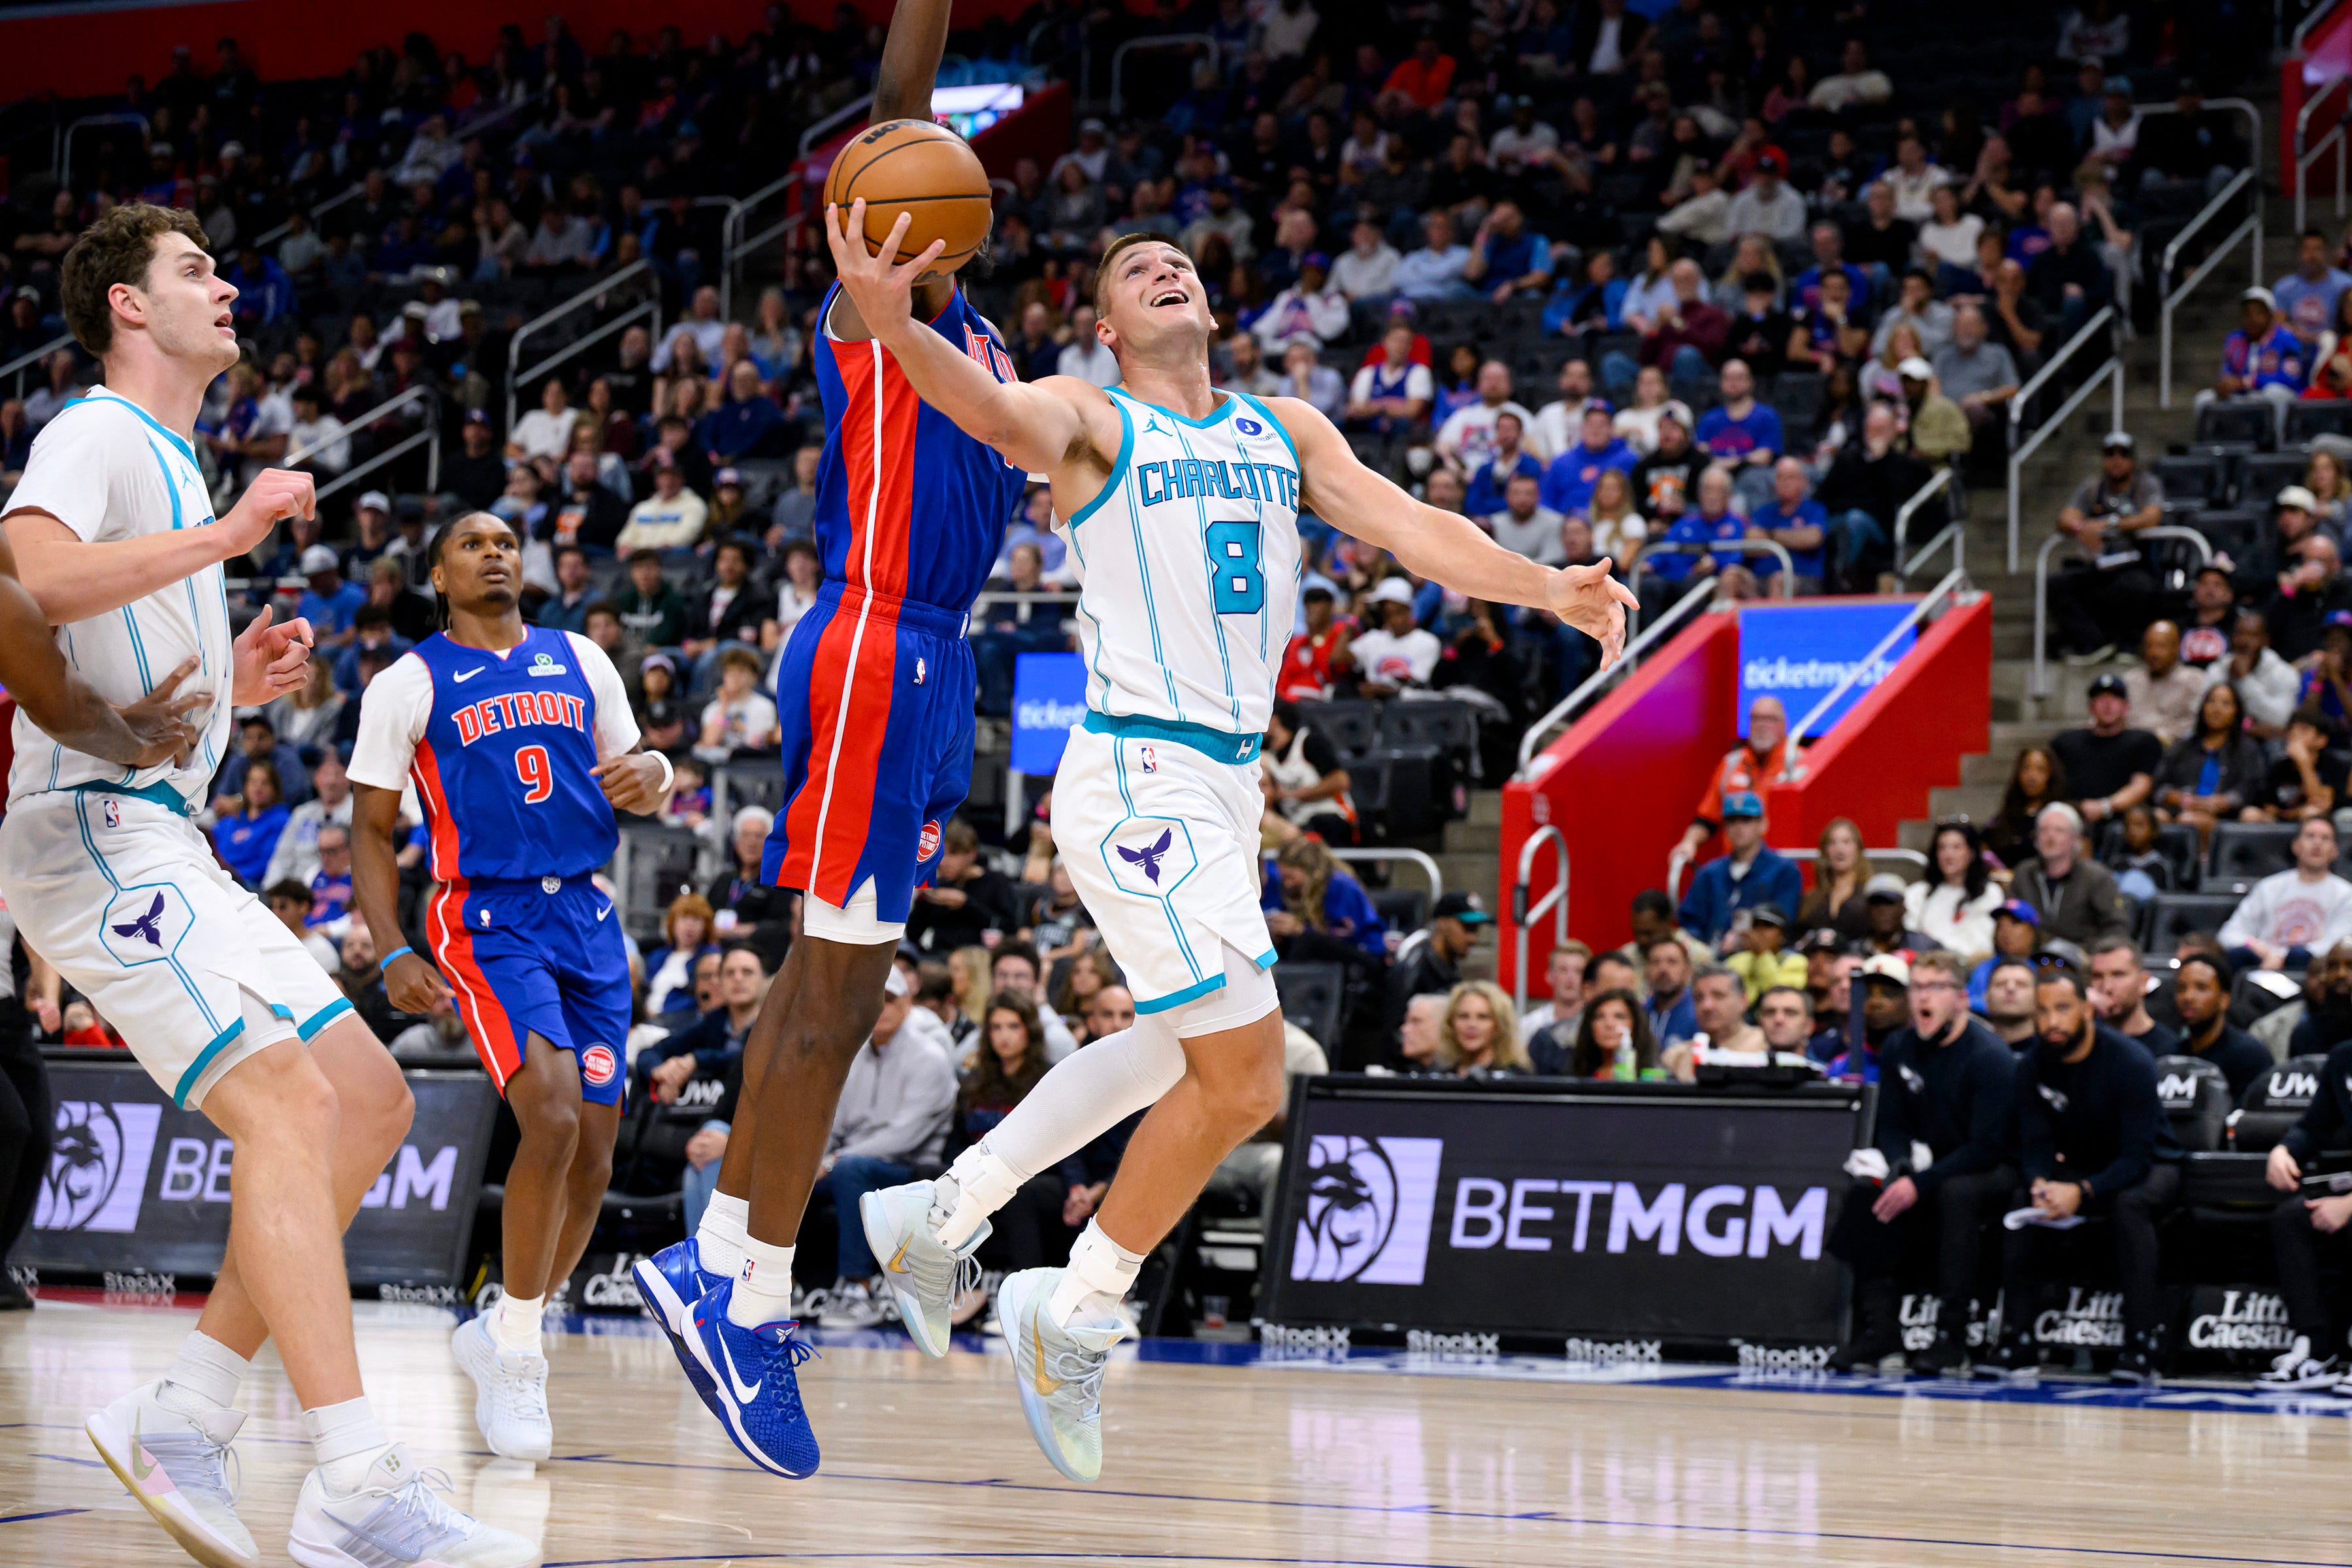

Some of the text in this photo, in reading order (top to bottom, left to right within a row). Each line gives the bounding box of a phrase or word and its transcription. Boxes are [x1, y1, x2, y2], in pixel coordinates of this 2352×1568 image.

[1137, 459, 1298, 514] CHARLOTTE
[1205, 521, 1264, 615] 8
[451, 691, 585, 747] DETROIT
[515, 745, 553, 804] 9
[1449, 1177, 1828, 1260] BETMGM
[1260, 1323, 1350, 1347] StockX
[1406, 1329, 1499, 1353] StockX
[1565, 1337, 1662, 1362] StockX
